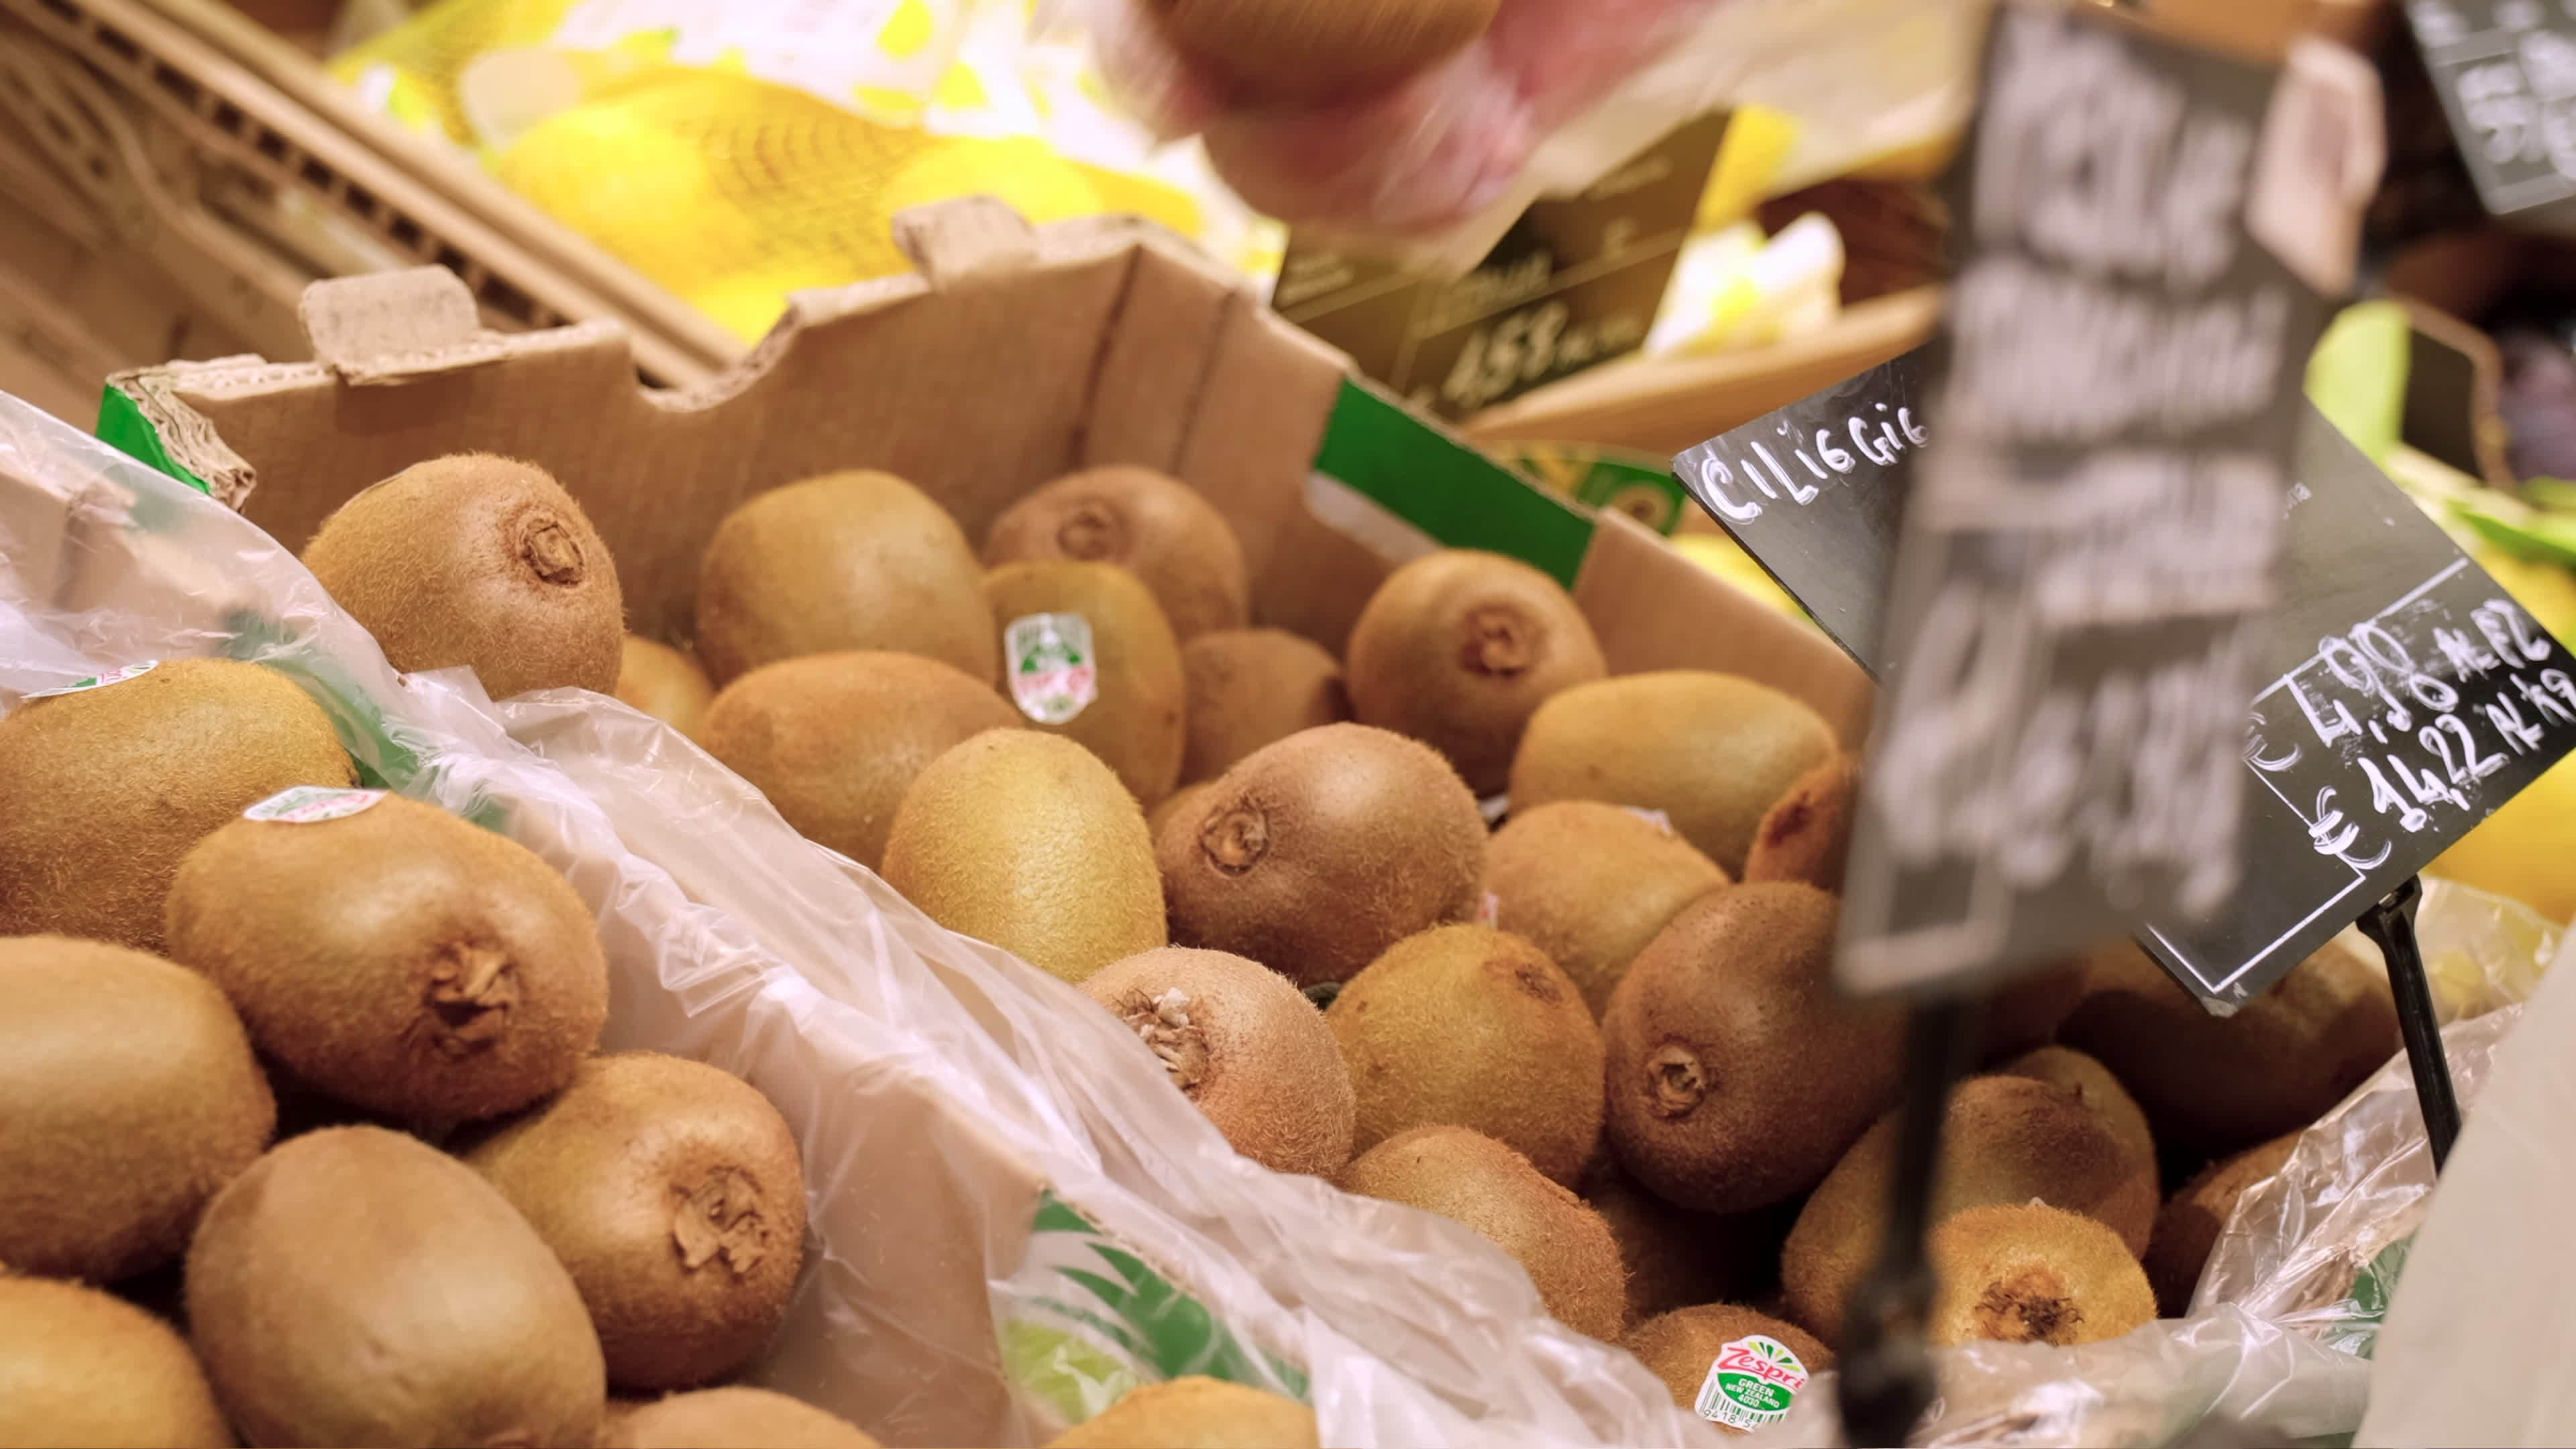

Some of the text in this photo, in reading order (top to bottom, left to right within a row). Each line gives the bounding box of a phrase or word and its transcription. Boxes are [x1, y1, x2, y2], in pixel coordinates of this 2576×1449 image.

[1717, 1346, 1806, 1390] Zespri
[1725, 1383, 1781, 1408] NEW ZEALAND
[1738, 1378, 1774, 1397] GREEN
[1738, 1395, 1760, 1408] 4030
